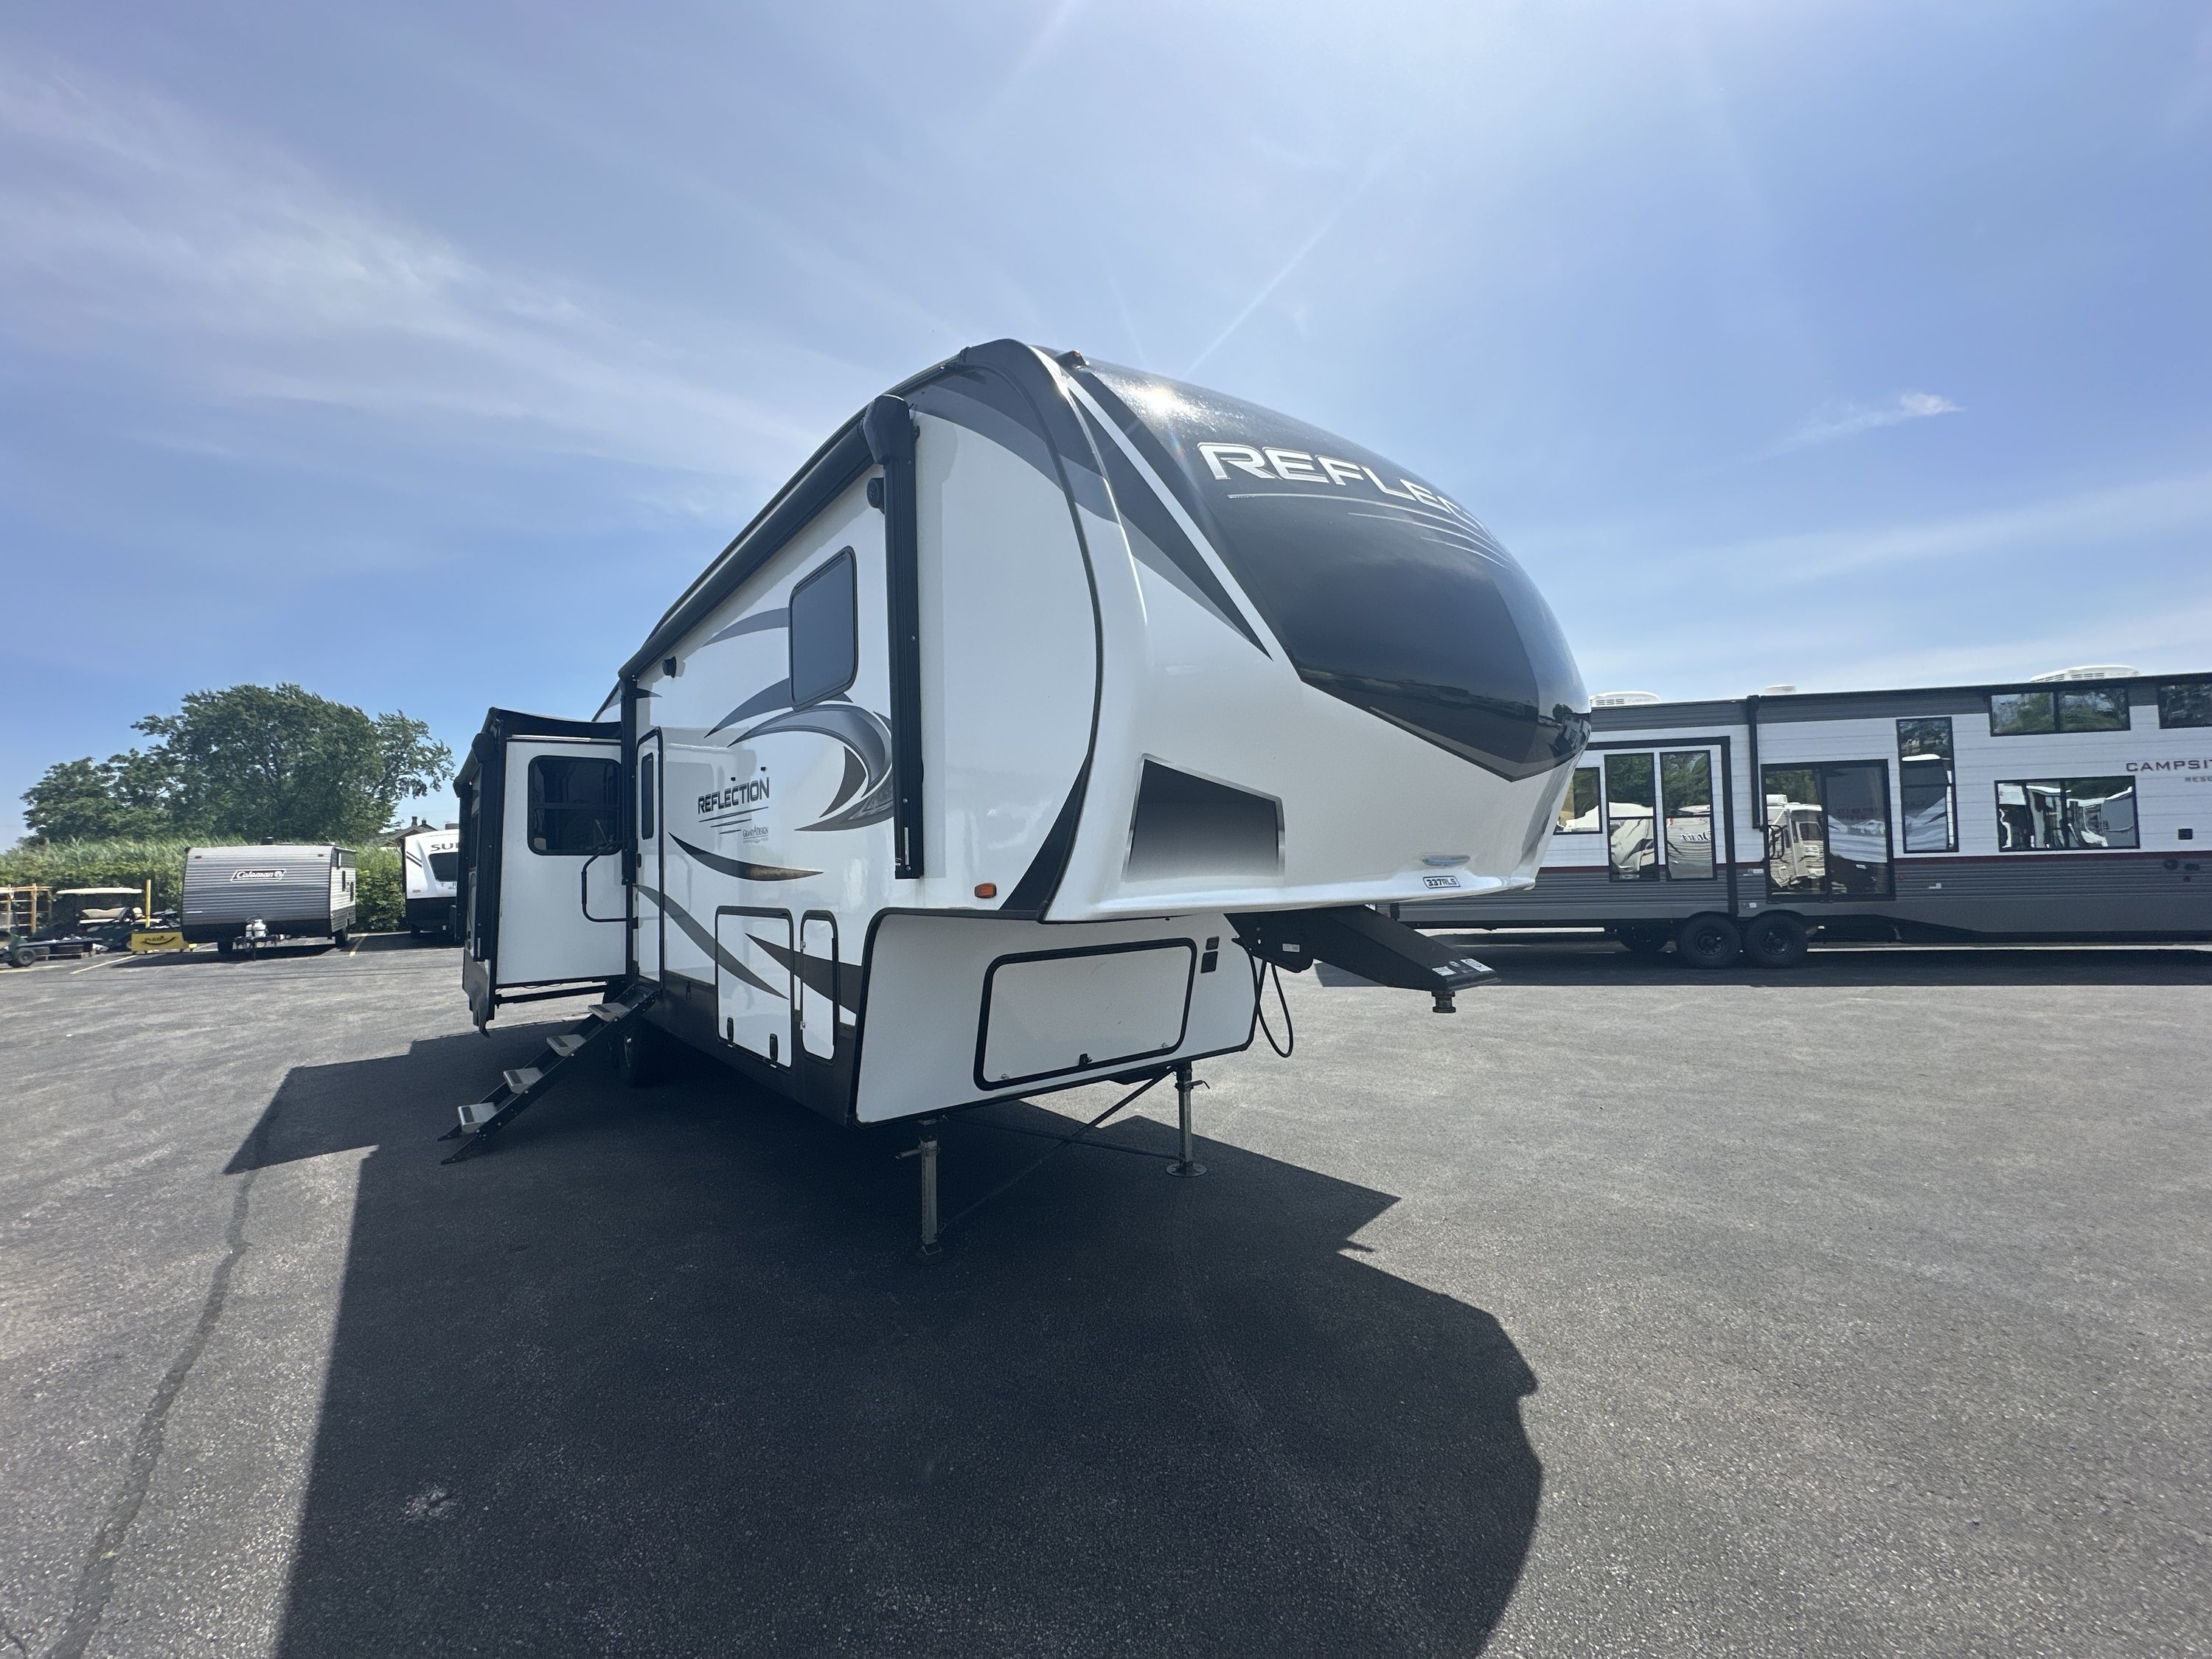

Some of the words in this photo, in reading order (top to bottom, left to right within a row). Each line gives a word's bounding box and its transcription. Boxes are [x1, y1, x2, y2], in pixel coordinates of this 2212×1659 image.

[698, 776, 770, 815] REFLECTION
[430, 842, 459, 852] SU
[236, 871, 274, 879] Coleman
[1426, 877, 1458, 886] 337RLS
